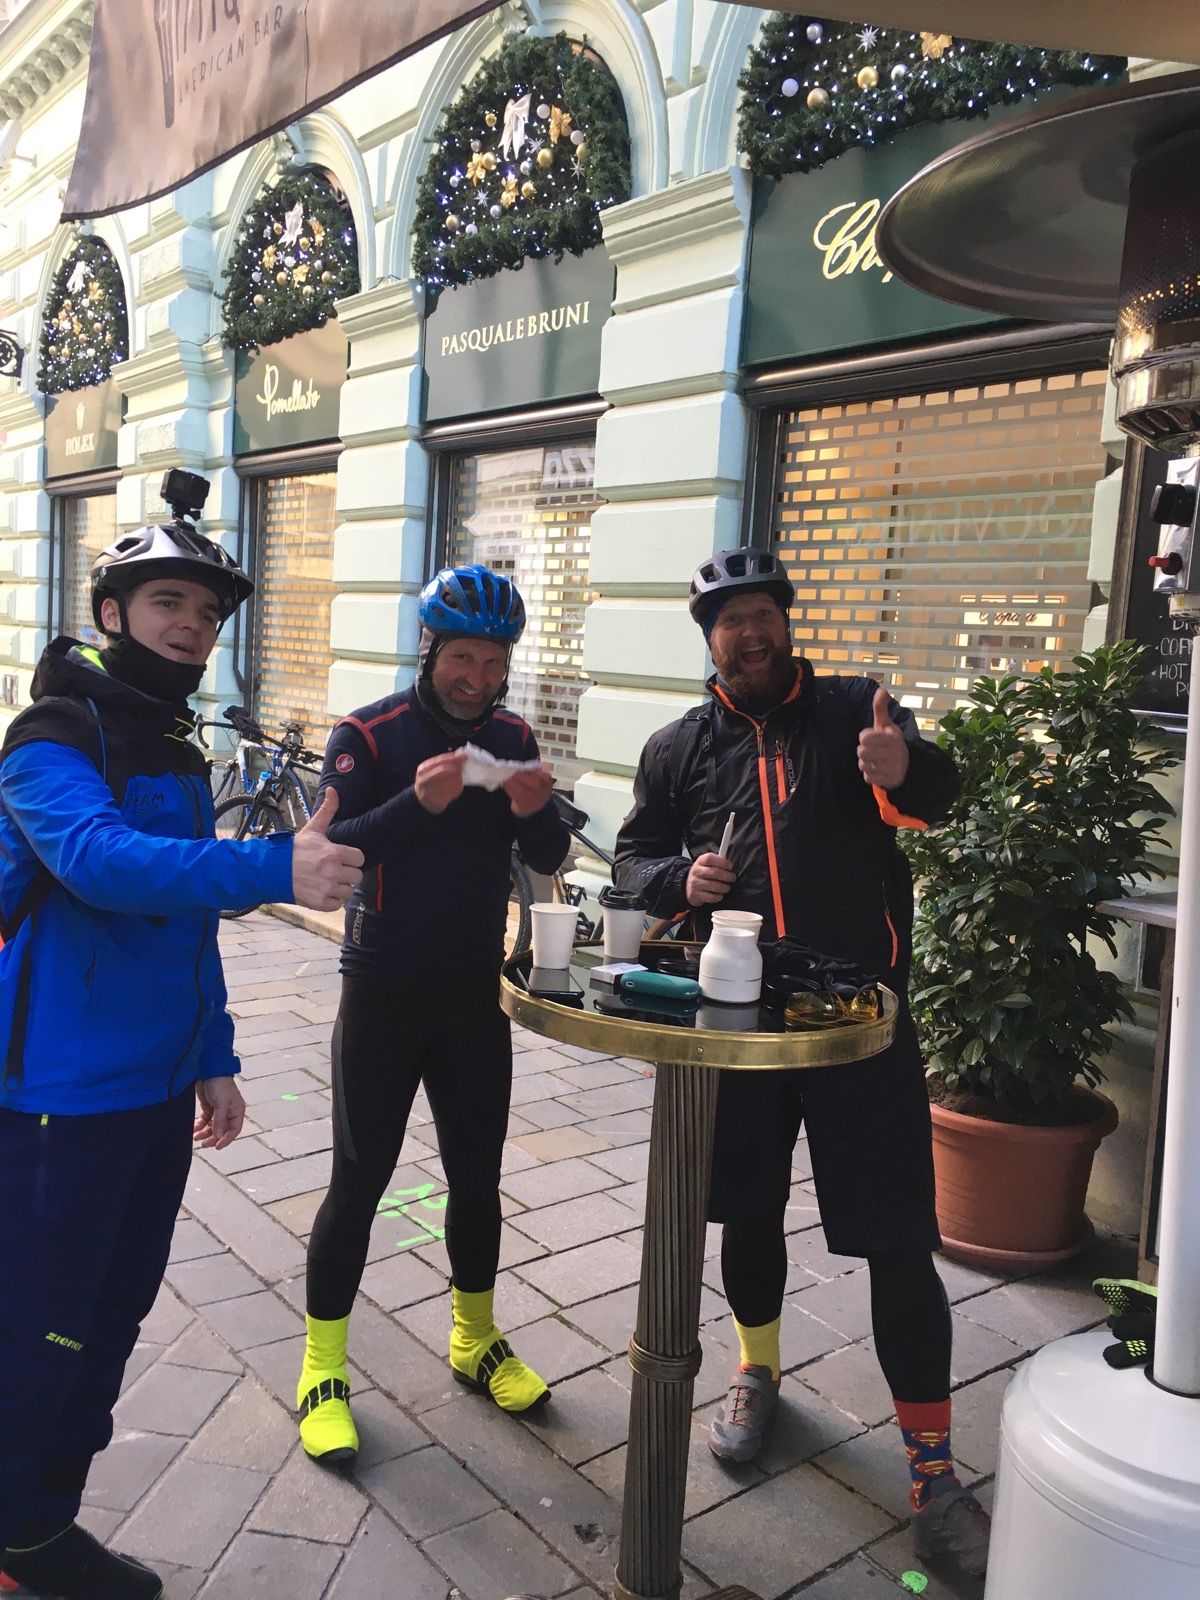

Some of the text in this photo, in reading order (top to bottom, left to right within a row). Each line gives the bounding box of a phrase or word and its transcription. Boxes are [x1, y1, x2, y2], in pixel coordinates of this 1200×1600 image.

[254, 5, 283, 46] BAR
[441, 301, 591, 357] PASQUALE BRUNI
[255, 363, 321, 422] Pomellato
[65, 432, 95, 457] ROLEX
[1159, 662, 1188, 680] HOT
